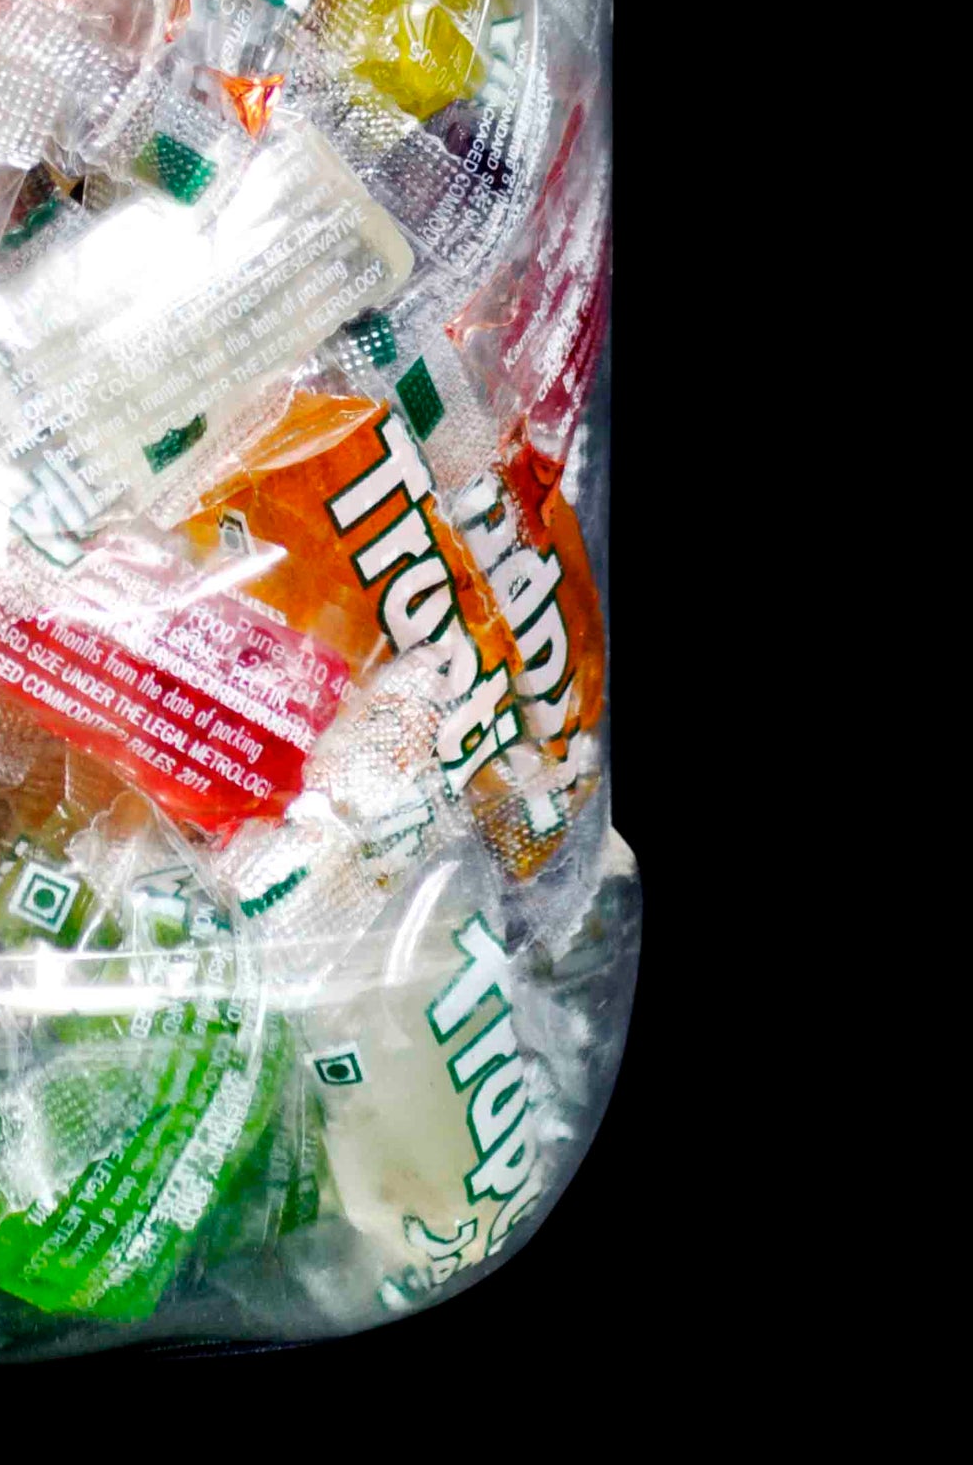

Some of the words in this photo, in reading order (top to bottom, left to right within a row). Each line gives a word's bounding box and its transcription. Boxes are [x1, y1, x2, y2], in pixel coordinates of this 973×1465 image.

[321, 409, 527, 799] Trupti
[24, 641, 66, 676] SIZE
[56, 662, 119, 709] UNDER
[110, 694, 148, 728] THE
[139, 712, 194, 754] LEGAL
[186, 736, 277, 801] METROLOGY
[46, 619, 109, 666] months
[101, 649, 149, 689] from
[136, 668, 168, 702] the
[159, 686, 198, 721] date
[191, 701, 218, 732] of
[205, 714, 268, 766] packing
